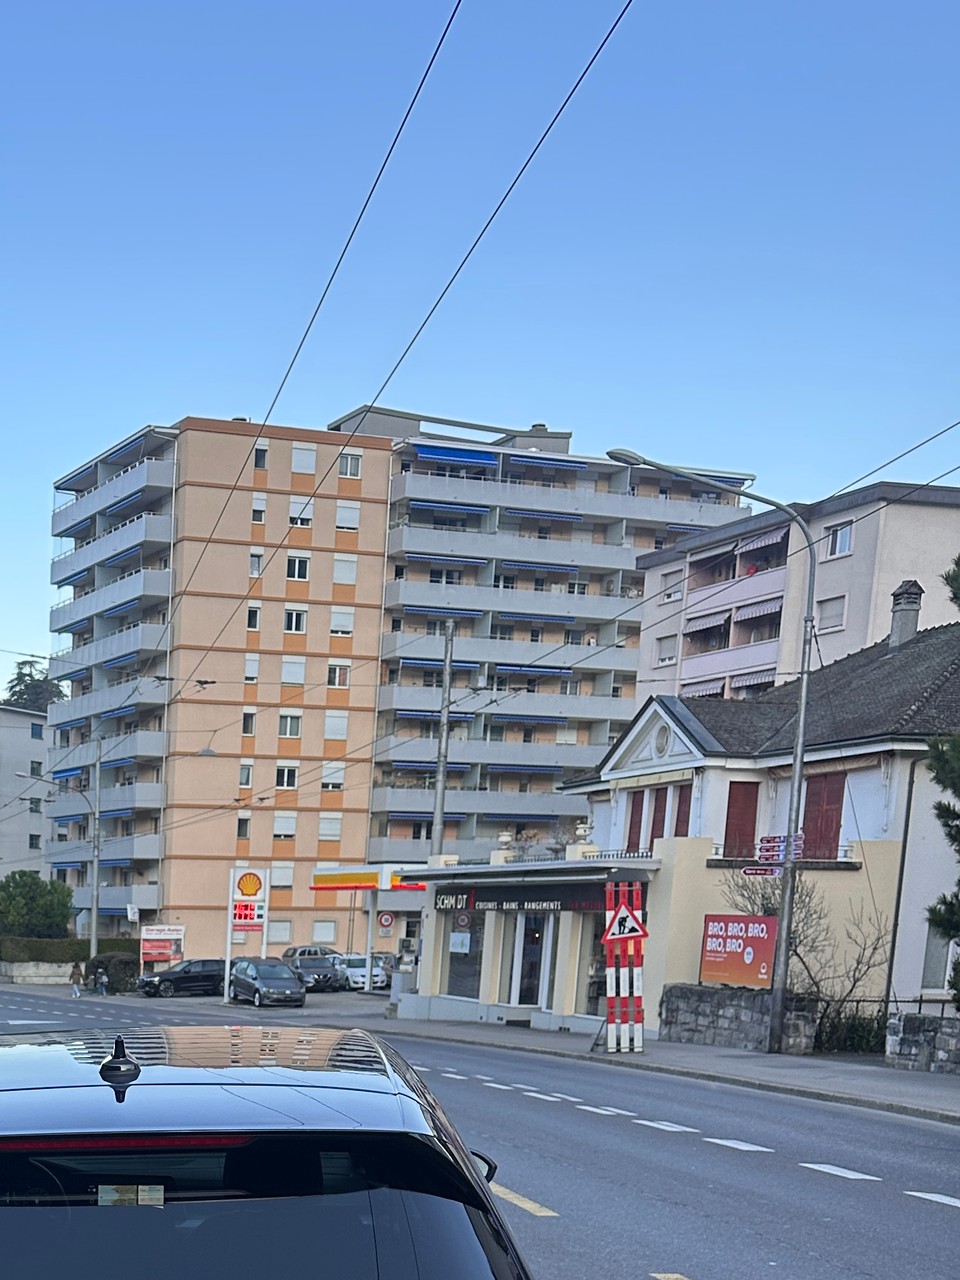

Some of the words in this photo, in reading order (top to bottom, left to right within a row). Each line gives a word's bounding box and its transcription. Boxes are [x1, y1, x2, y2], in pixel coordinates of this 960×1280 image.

[436, 894, 468, 909] SCHMDT
[475, 901, 498, 910] CUISINES
[503, 901, 519, 910] BAINS
[524, 901, 561, 910] RANGEMENTS
[708, 922, 726, 938] BRO,
[727, 922, 747, 939] BRO,
[748, 923, 768, 940] BRO,
[706, 937, 724, 953] BRO,
[726, 938, 744, 953] BRO
